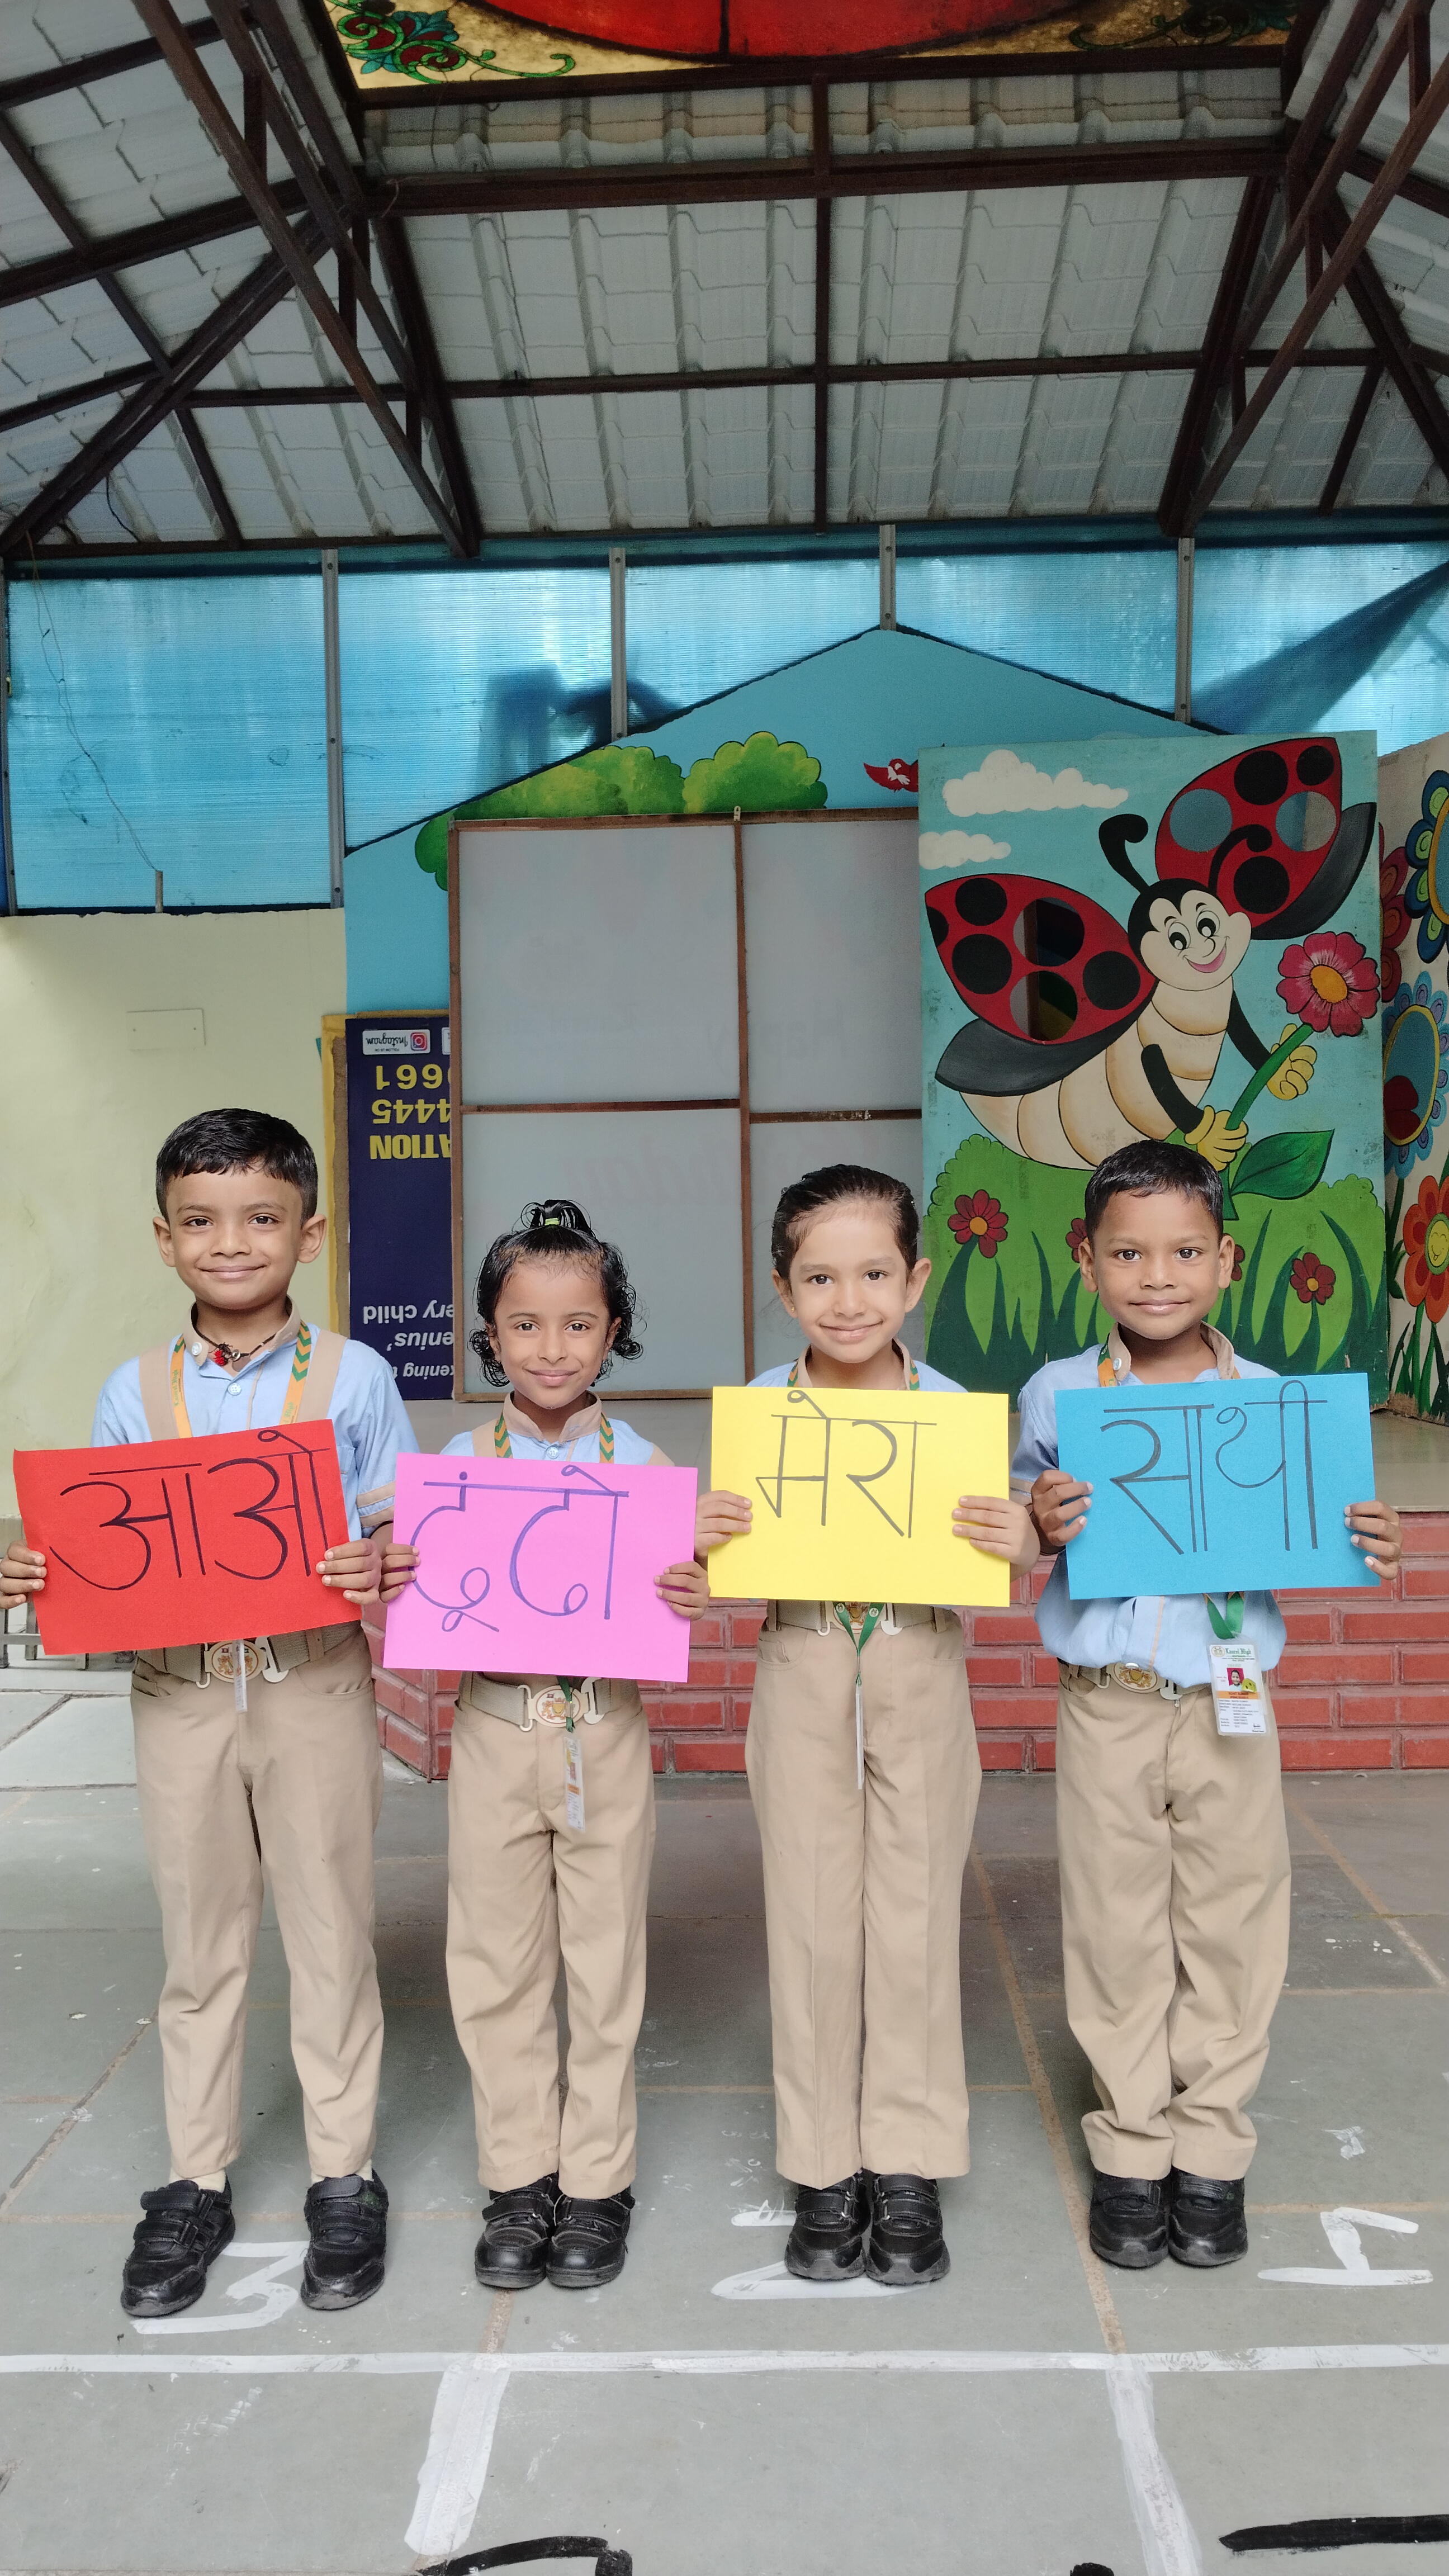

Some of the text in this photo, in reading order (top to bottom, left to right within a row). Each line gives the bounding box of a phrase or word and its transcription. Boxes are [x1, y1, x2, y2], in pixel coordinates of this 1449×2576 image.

[366, 1033, 408, 1048] Instagram
[377, 1064, 451, 1090] 661
[372, 1098, 451, 1124] 4445
[363, 1305, 417, 1324] child
[755, 1389, 937, 1539] मेरा
[1100, 1379, 1328, 1555] साथी
[49, 1429, 331, 1591] आओ
